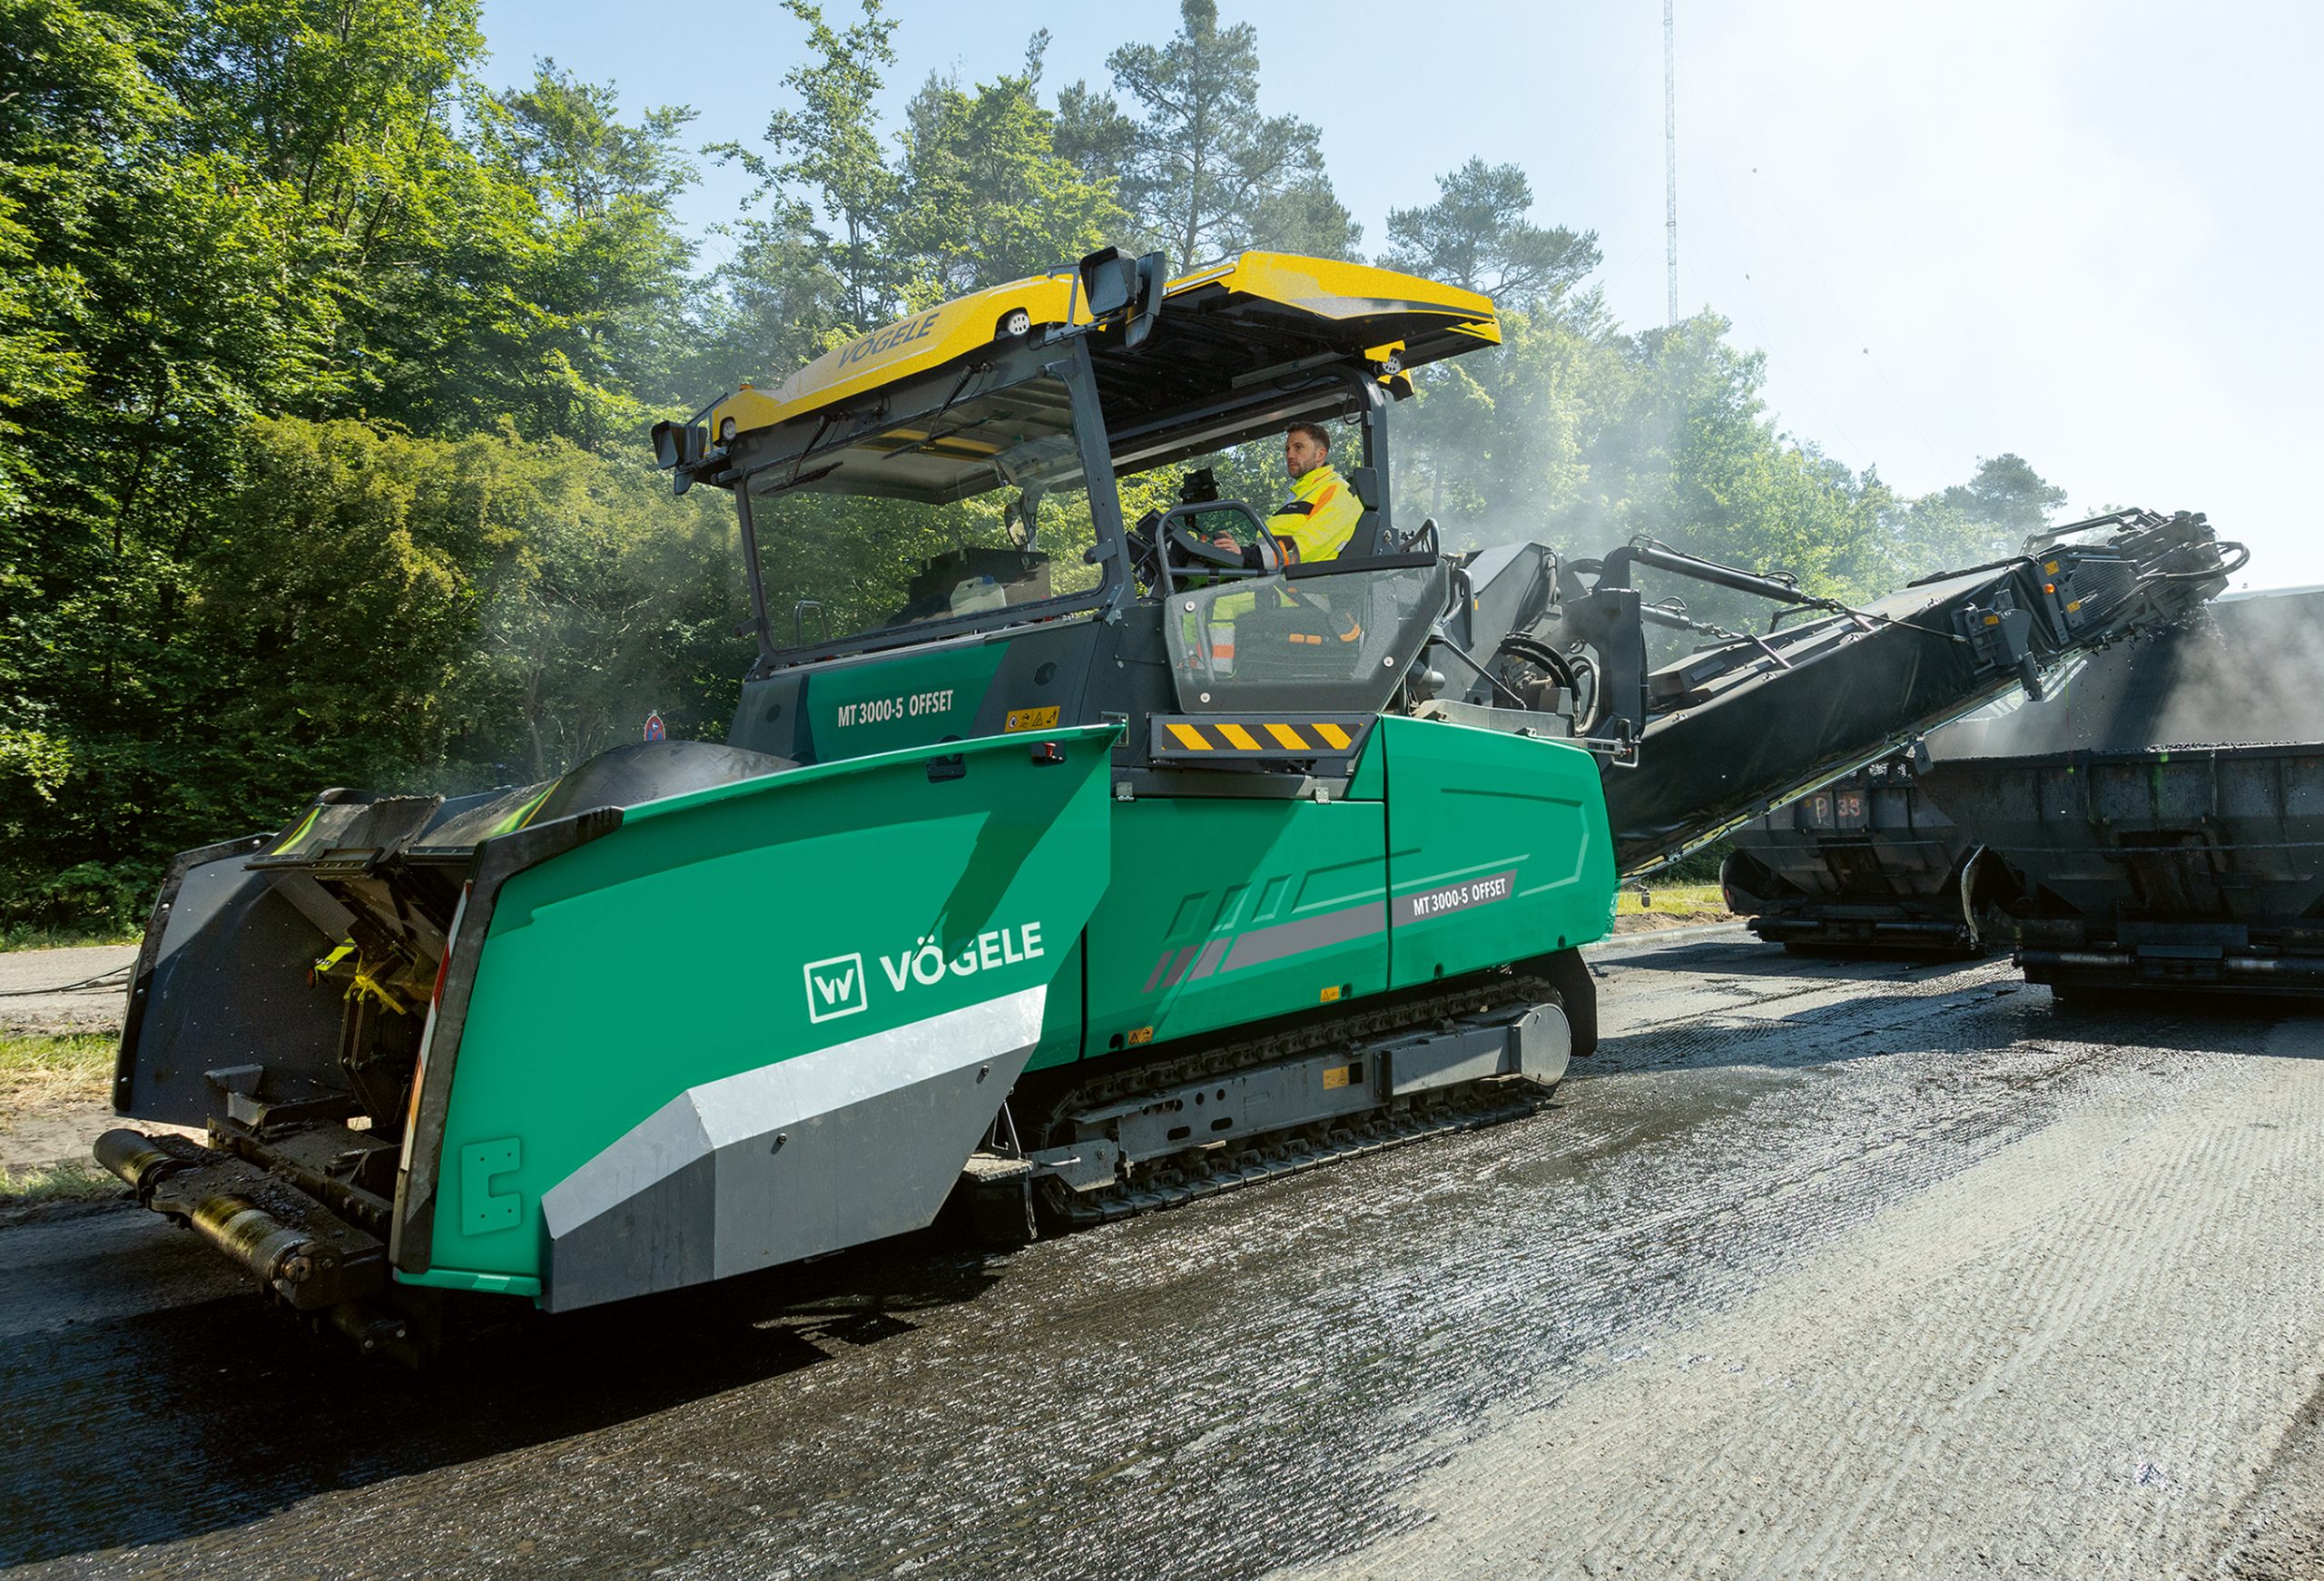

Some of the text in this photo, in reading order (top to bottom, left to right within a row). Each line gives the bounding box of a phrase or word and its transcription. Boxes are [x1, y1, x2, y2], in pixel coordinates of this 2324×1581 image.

[838, 312, 940, 368] VÖGELE
[838, 689, 953, 727] MT 3000-5 OFFSET
[1413, 878, 1505, 916] MT 3000-5 OFFSET
